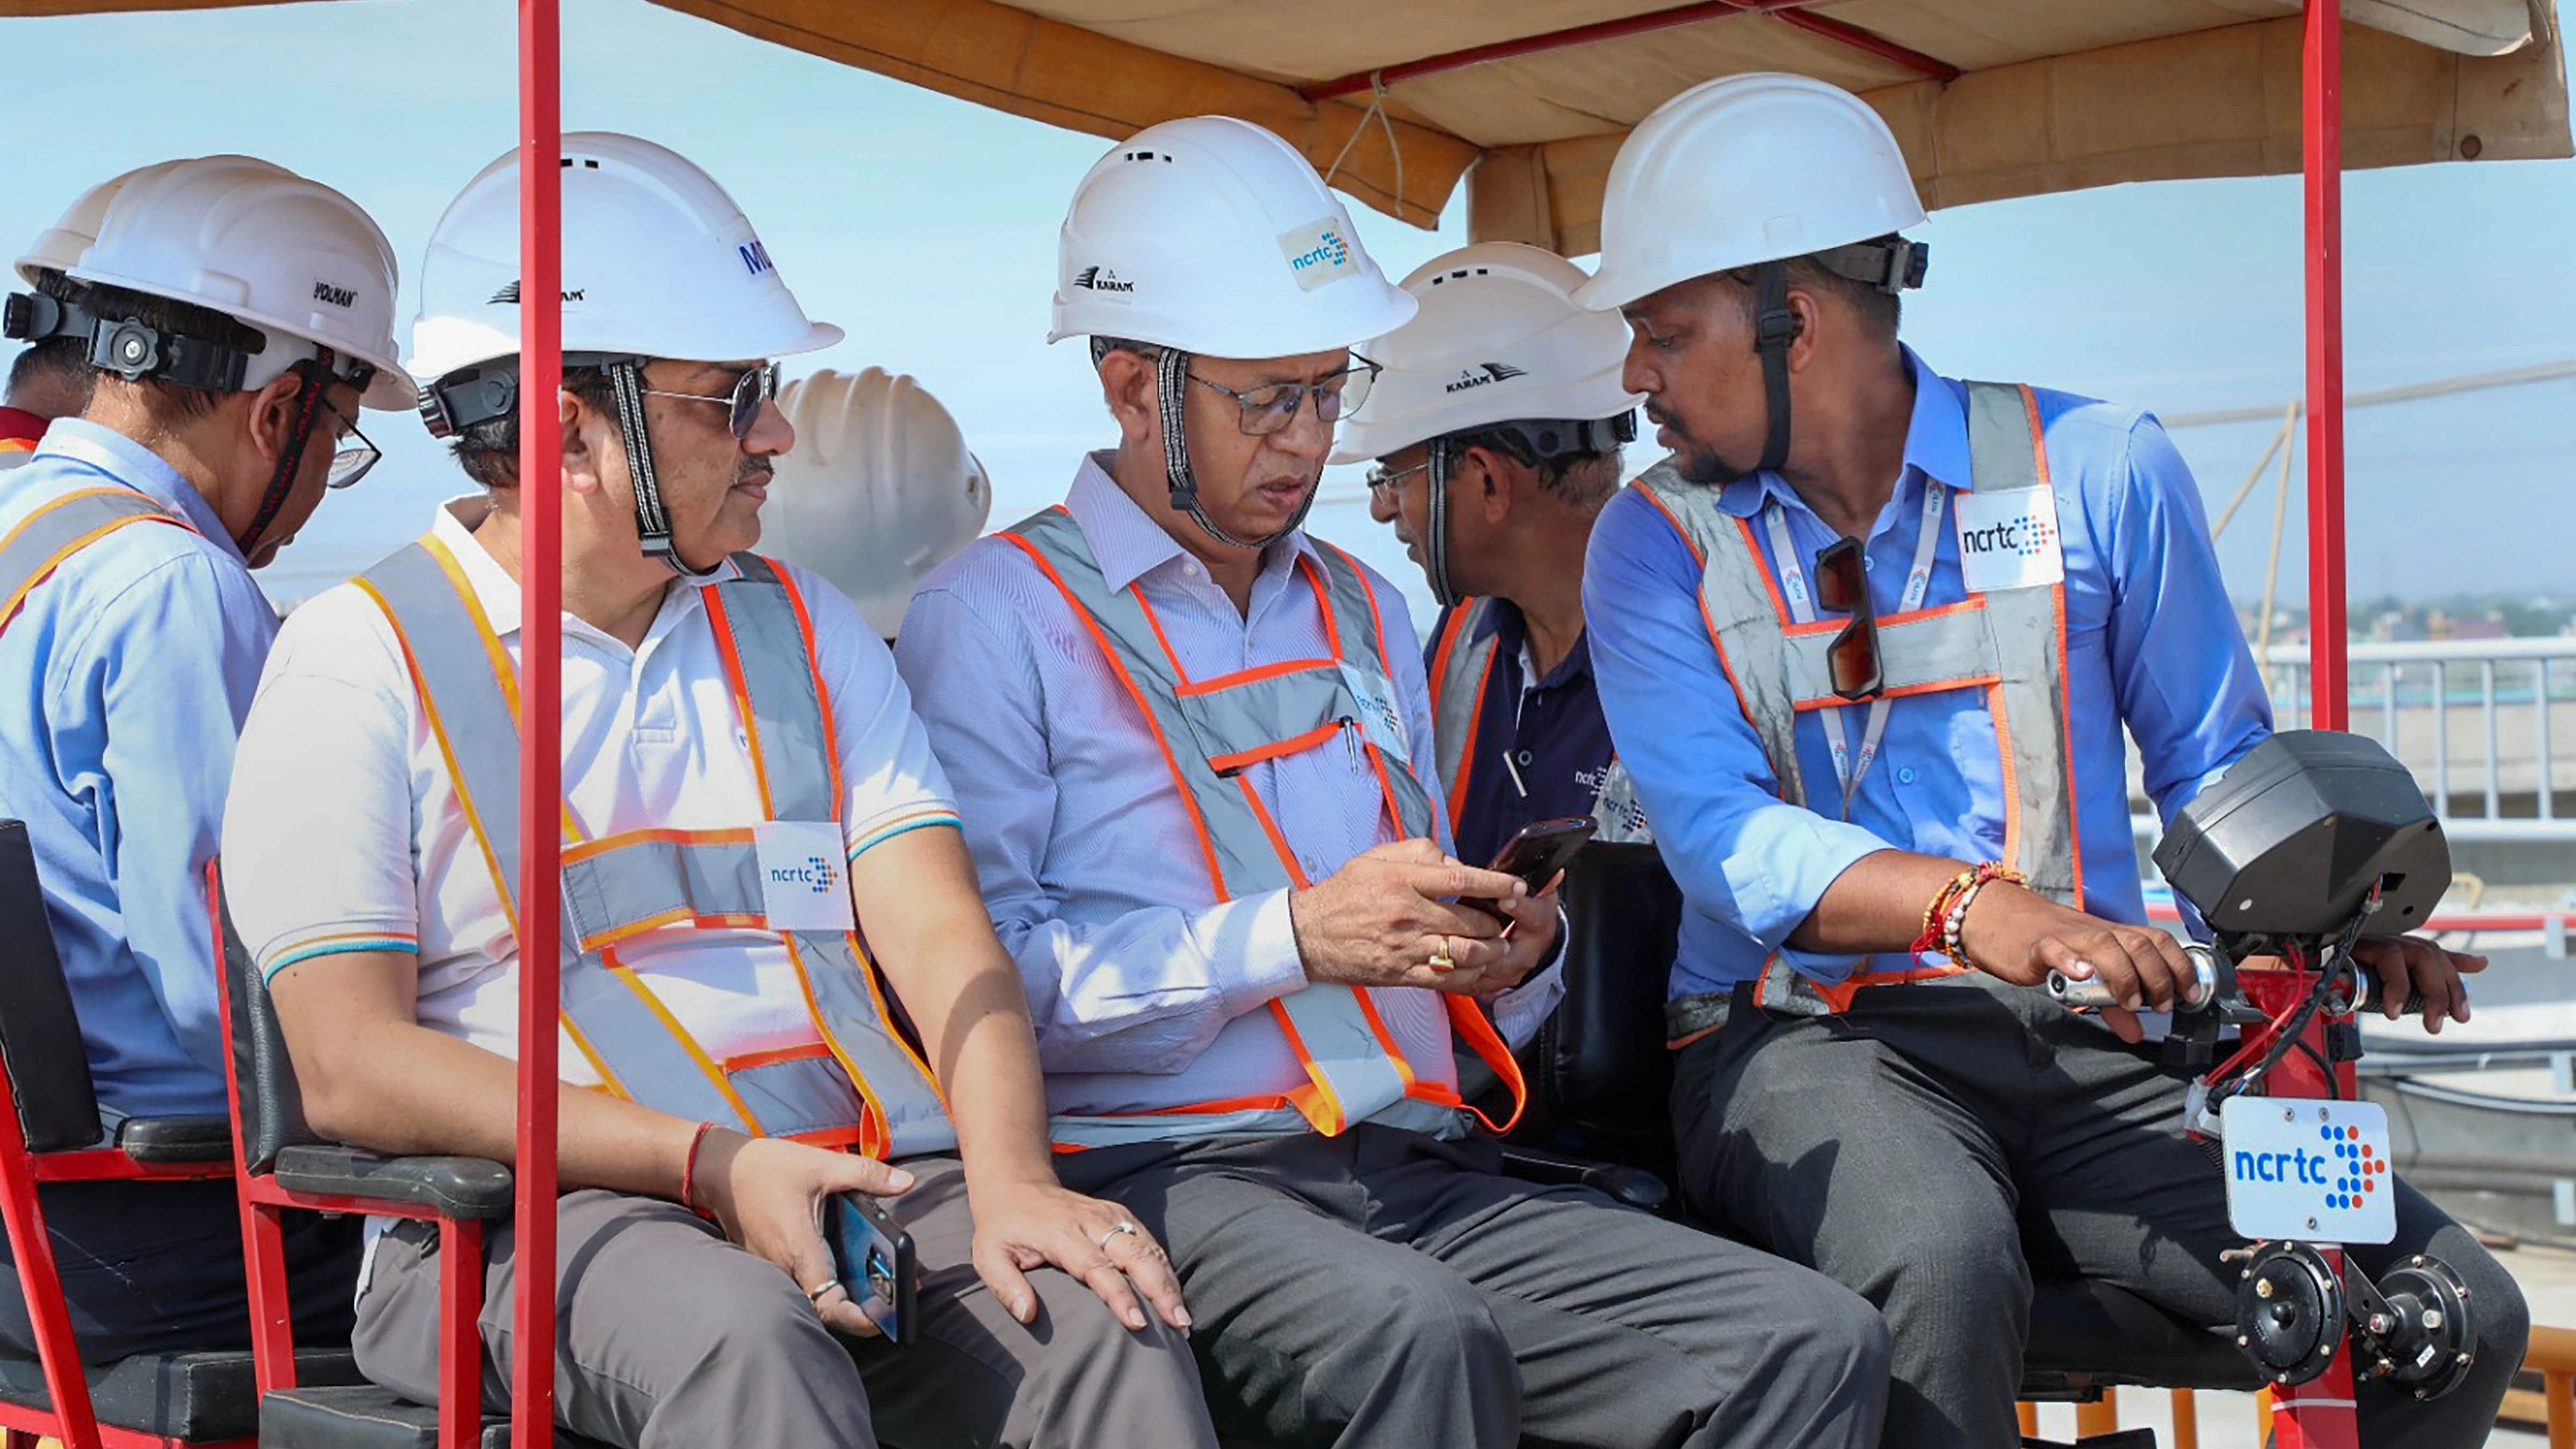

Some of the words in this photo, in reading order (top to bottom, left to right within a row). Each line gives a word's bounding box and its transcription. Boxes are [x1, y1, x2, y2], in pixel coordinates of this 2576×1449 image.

[1292, 246, 1333, 270] ncrtc
[1096, 280, 1133, 292] KARAM
[1446, 374, 1491, 393] KARAM
[1963, 521, 2018, 553] ncrtc
[772, 866, 812, 882] ncrtc
[2235, 1147, 2327, 1184] ncrtc
